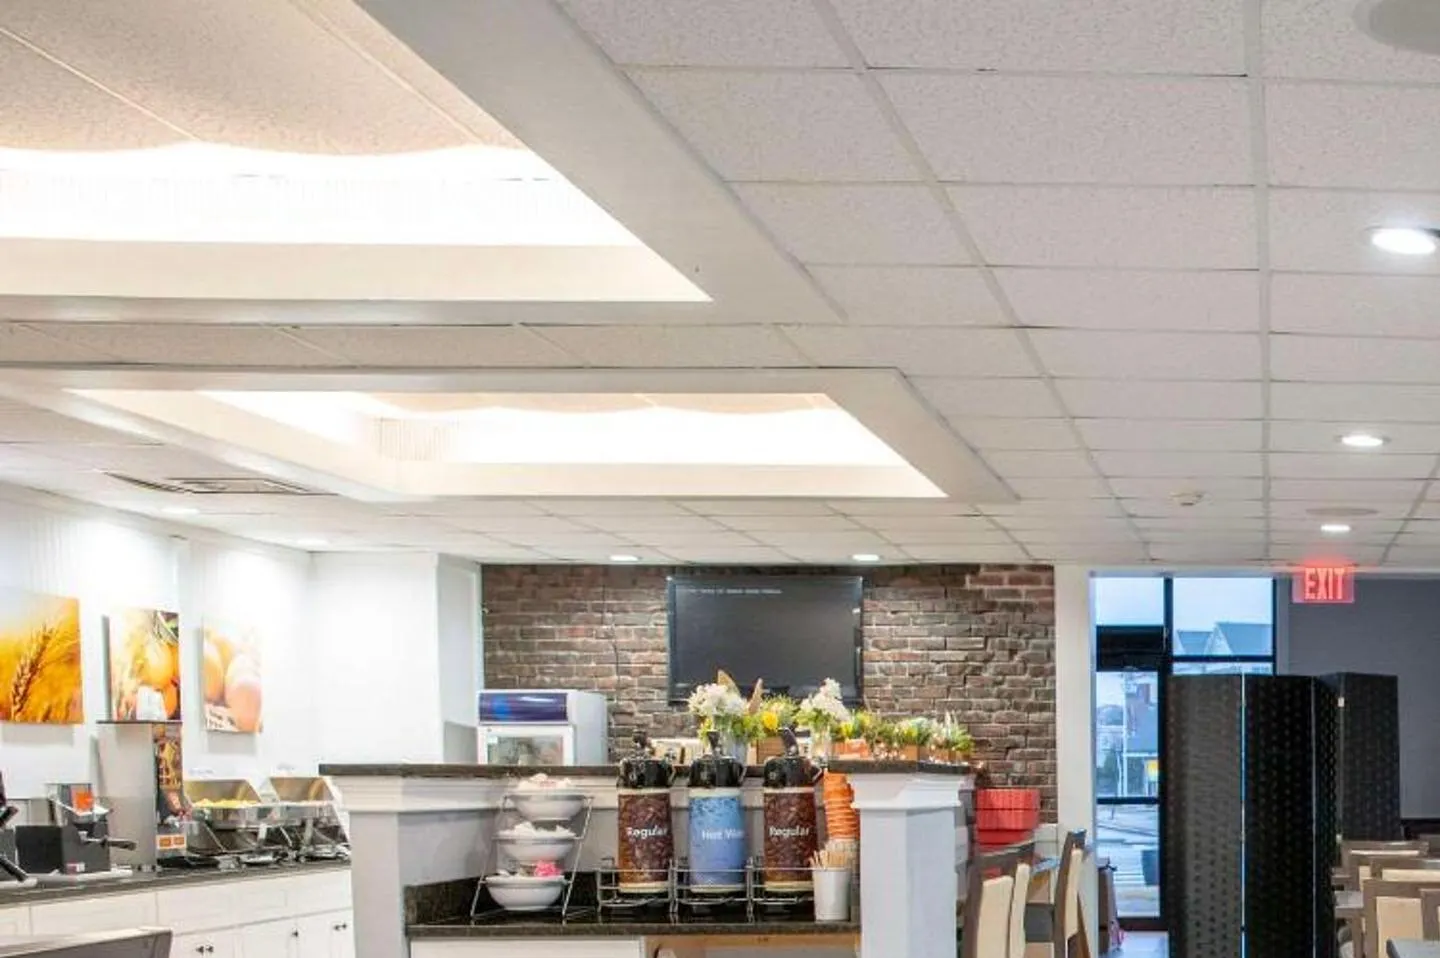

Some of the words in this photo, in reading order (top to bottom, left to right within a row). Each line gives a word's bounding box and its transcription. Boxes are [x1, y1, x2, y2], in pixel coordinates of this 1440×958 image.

[1304, 567, 1345, 600] EXIT
[625, 825, 668, 840] Regular
[769, 825, 810, 840] Regular
